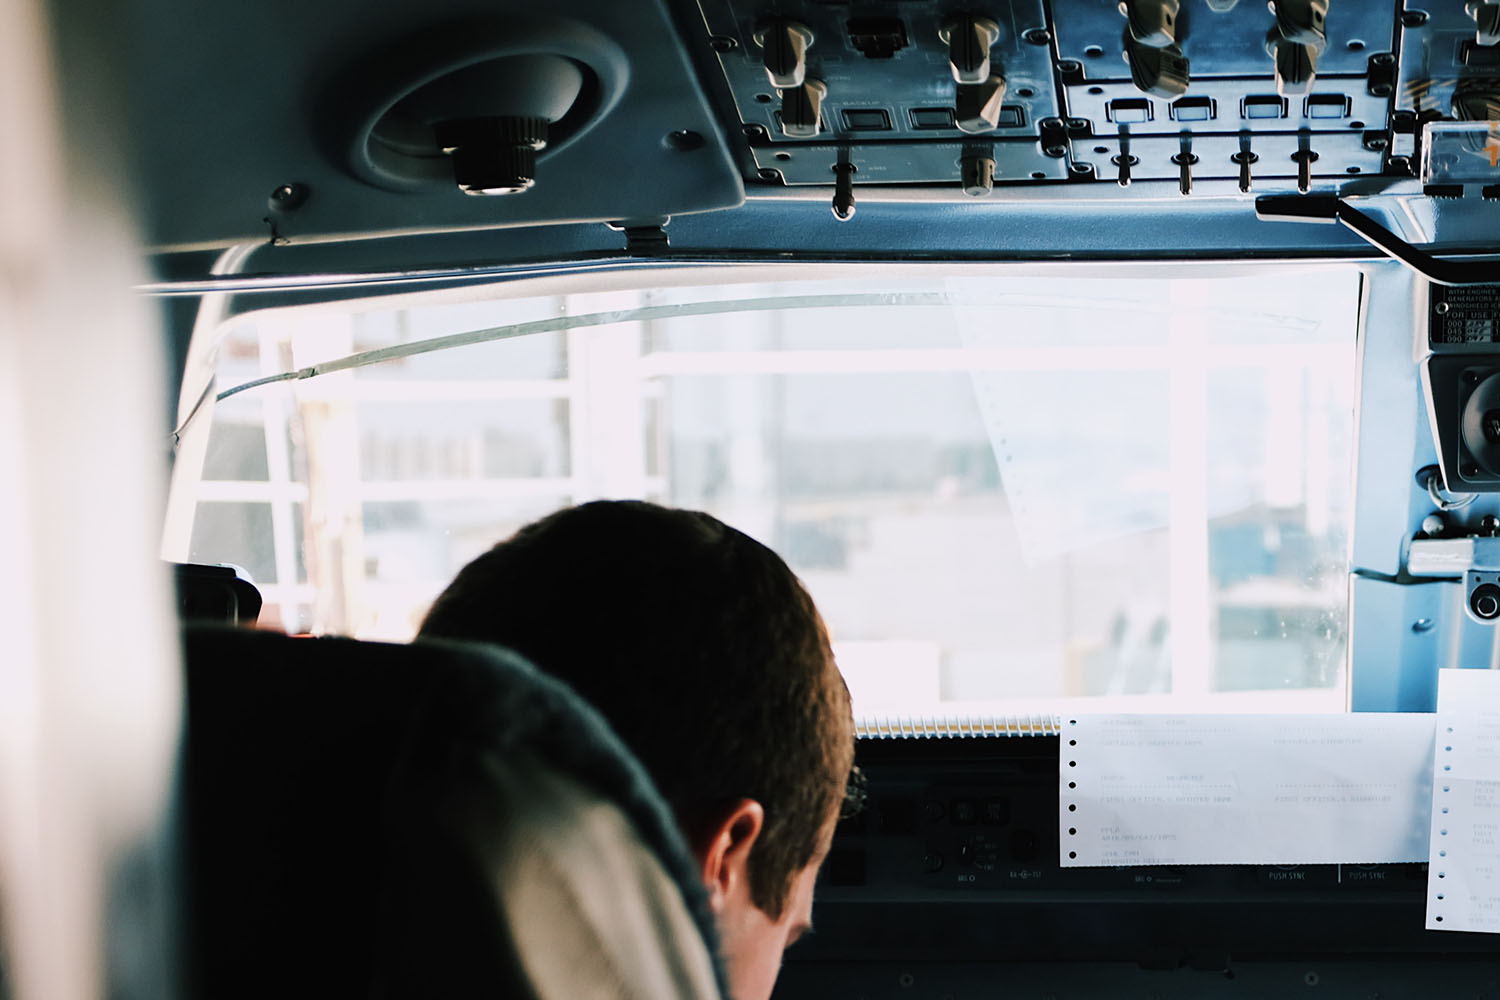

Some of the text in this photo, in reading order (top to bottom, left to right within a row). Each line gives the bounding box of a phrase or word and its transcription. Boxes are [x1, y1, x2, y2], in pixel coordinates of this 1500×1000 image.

[1483, 144, 1499, 167] 1
[1447, 288, 1466, 296] WITH
[1447, 295, 1495, 303] GENERATORS
[1446, 311, 1465, 319] FOR
[1470, 311, 1489, 319] USE
[1447, 320, 1463, 328] 000
[1447, 335, 1463, 343] 090
[1268, 871, 1306, 881] PUSH SYNC
[1348, 871, 1386, 880] PUSH SYNC
